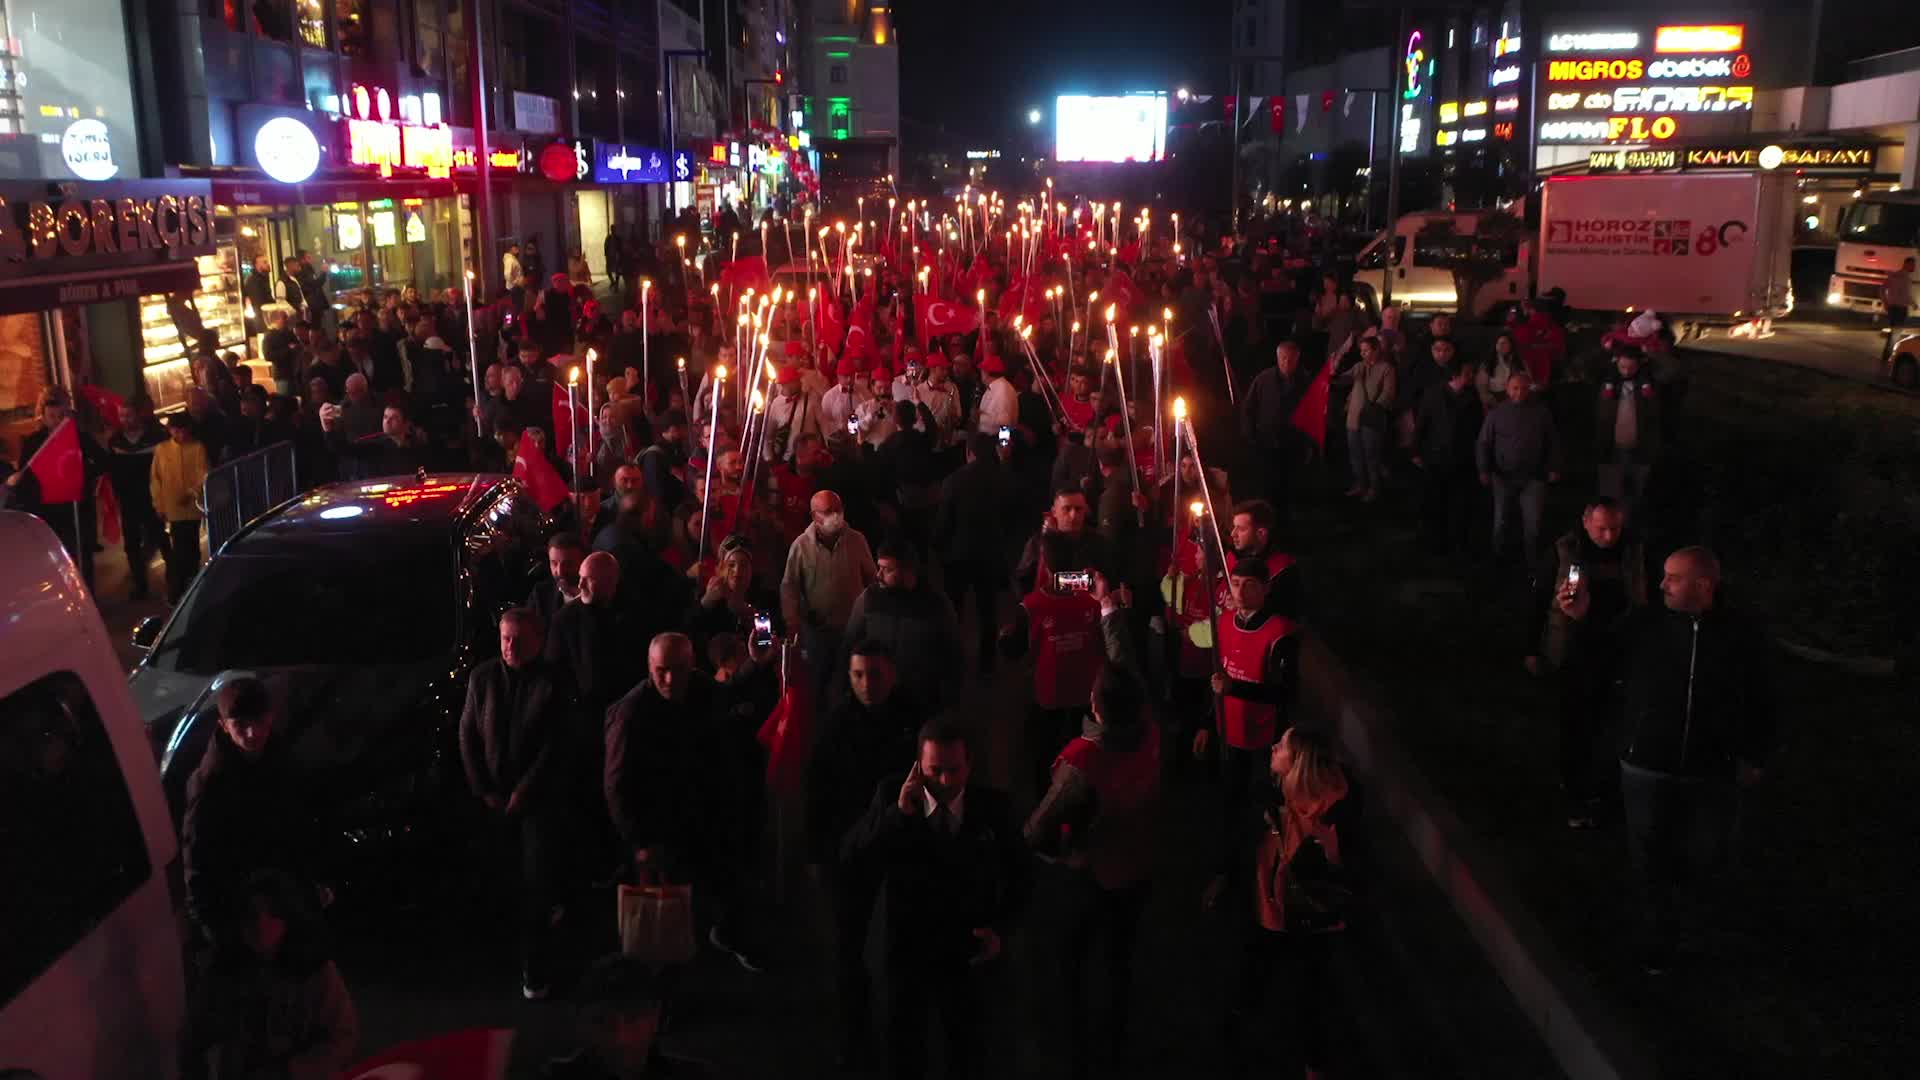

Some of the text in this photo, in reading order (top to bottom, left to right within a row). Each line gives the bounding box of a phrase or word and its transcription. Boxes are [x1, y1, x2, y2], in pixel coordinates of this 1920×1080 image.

[1549, 60, 1643, 80] MIGROS
[1608, 117, 1676, 140] FLO
[1575, 219, 1651, 232] HOROZ
